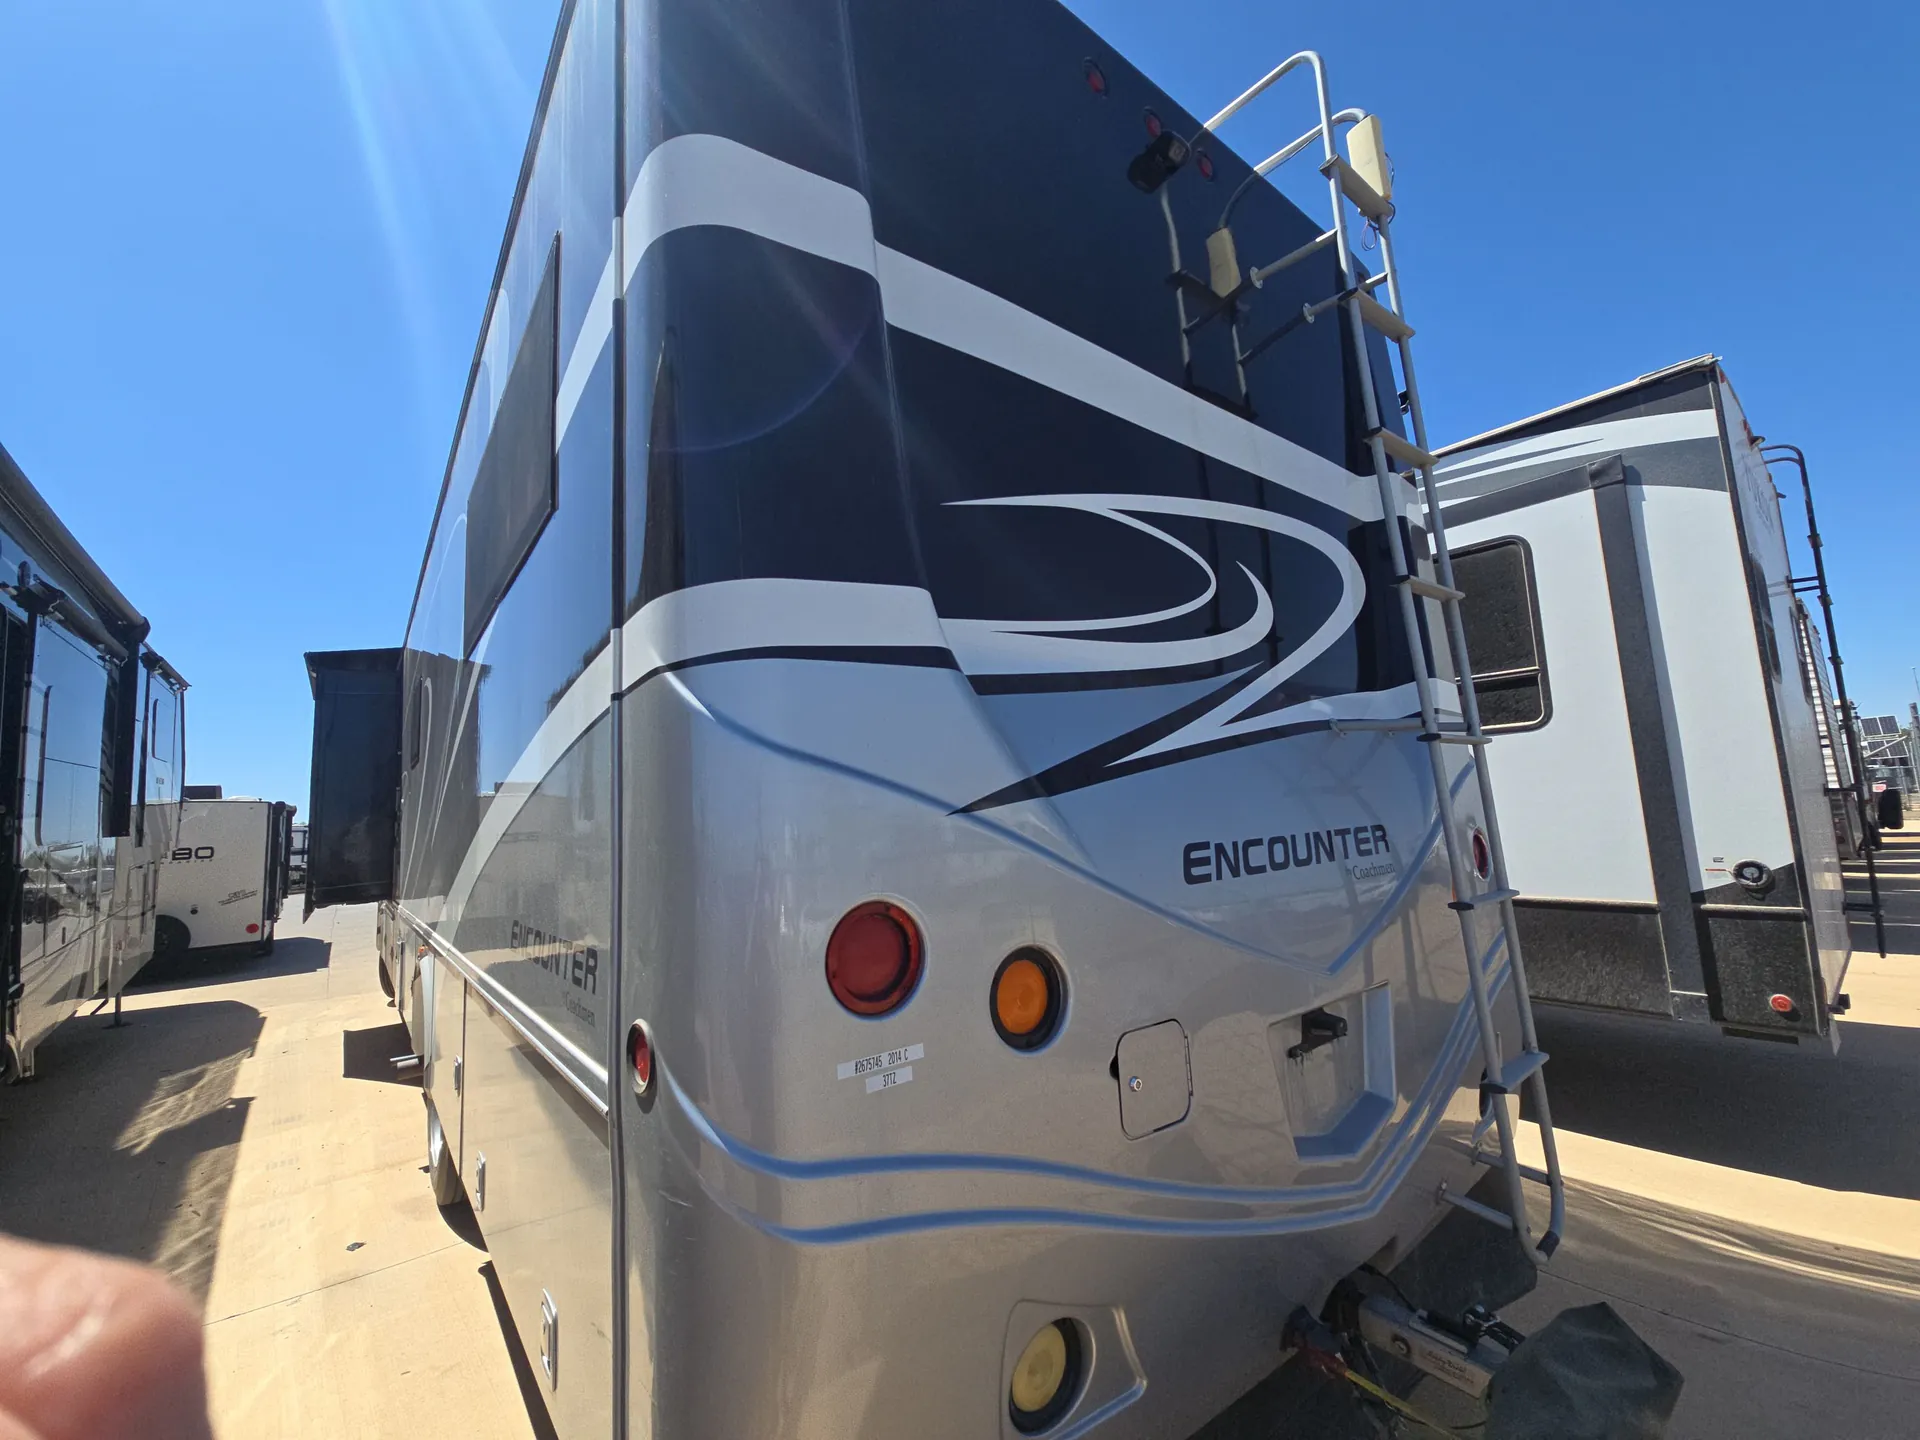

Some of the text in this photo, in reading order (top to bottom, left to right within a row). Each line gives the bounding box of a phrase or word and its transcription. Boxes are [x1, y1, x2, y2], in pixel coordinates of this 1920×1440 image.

[1183, 824, 1390, 885] ENCOUNTER
[1352, 862, 1396, 880] Coachmen
[510, 920, 598, 995] ENCOUNTER
[887, 1050, 902, 1065] 2014
[903, 1048, 909, 1061] C
